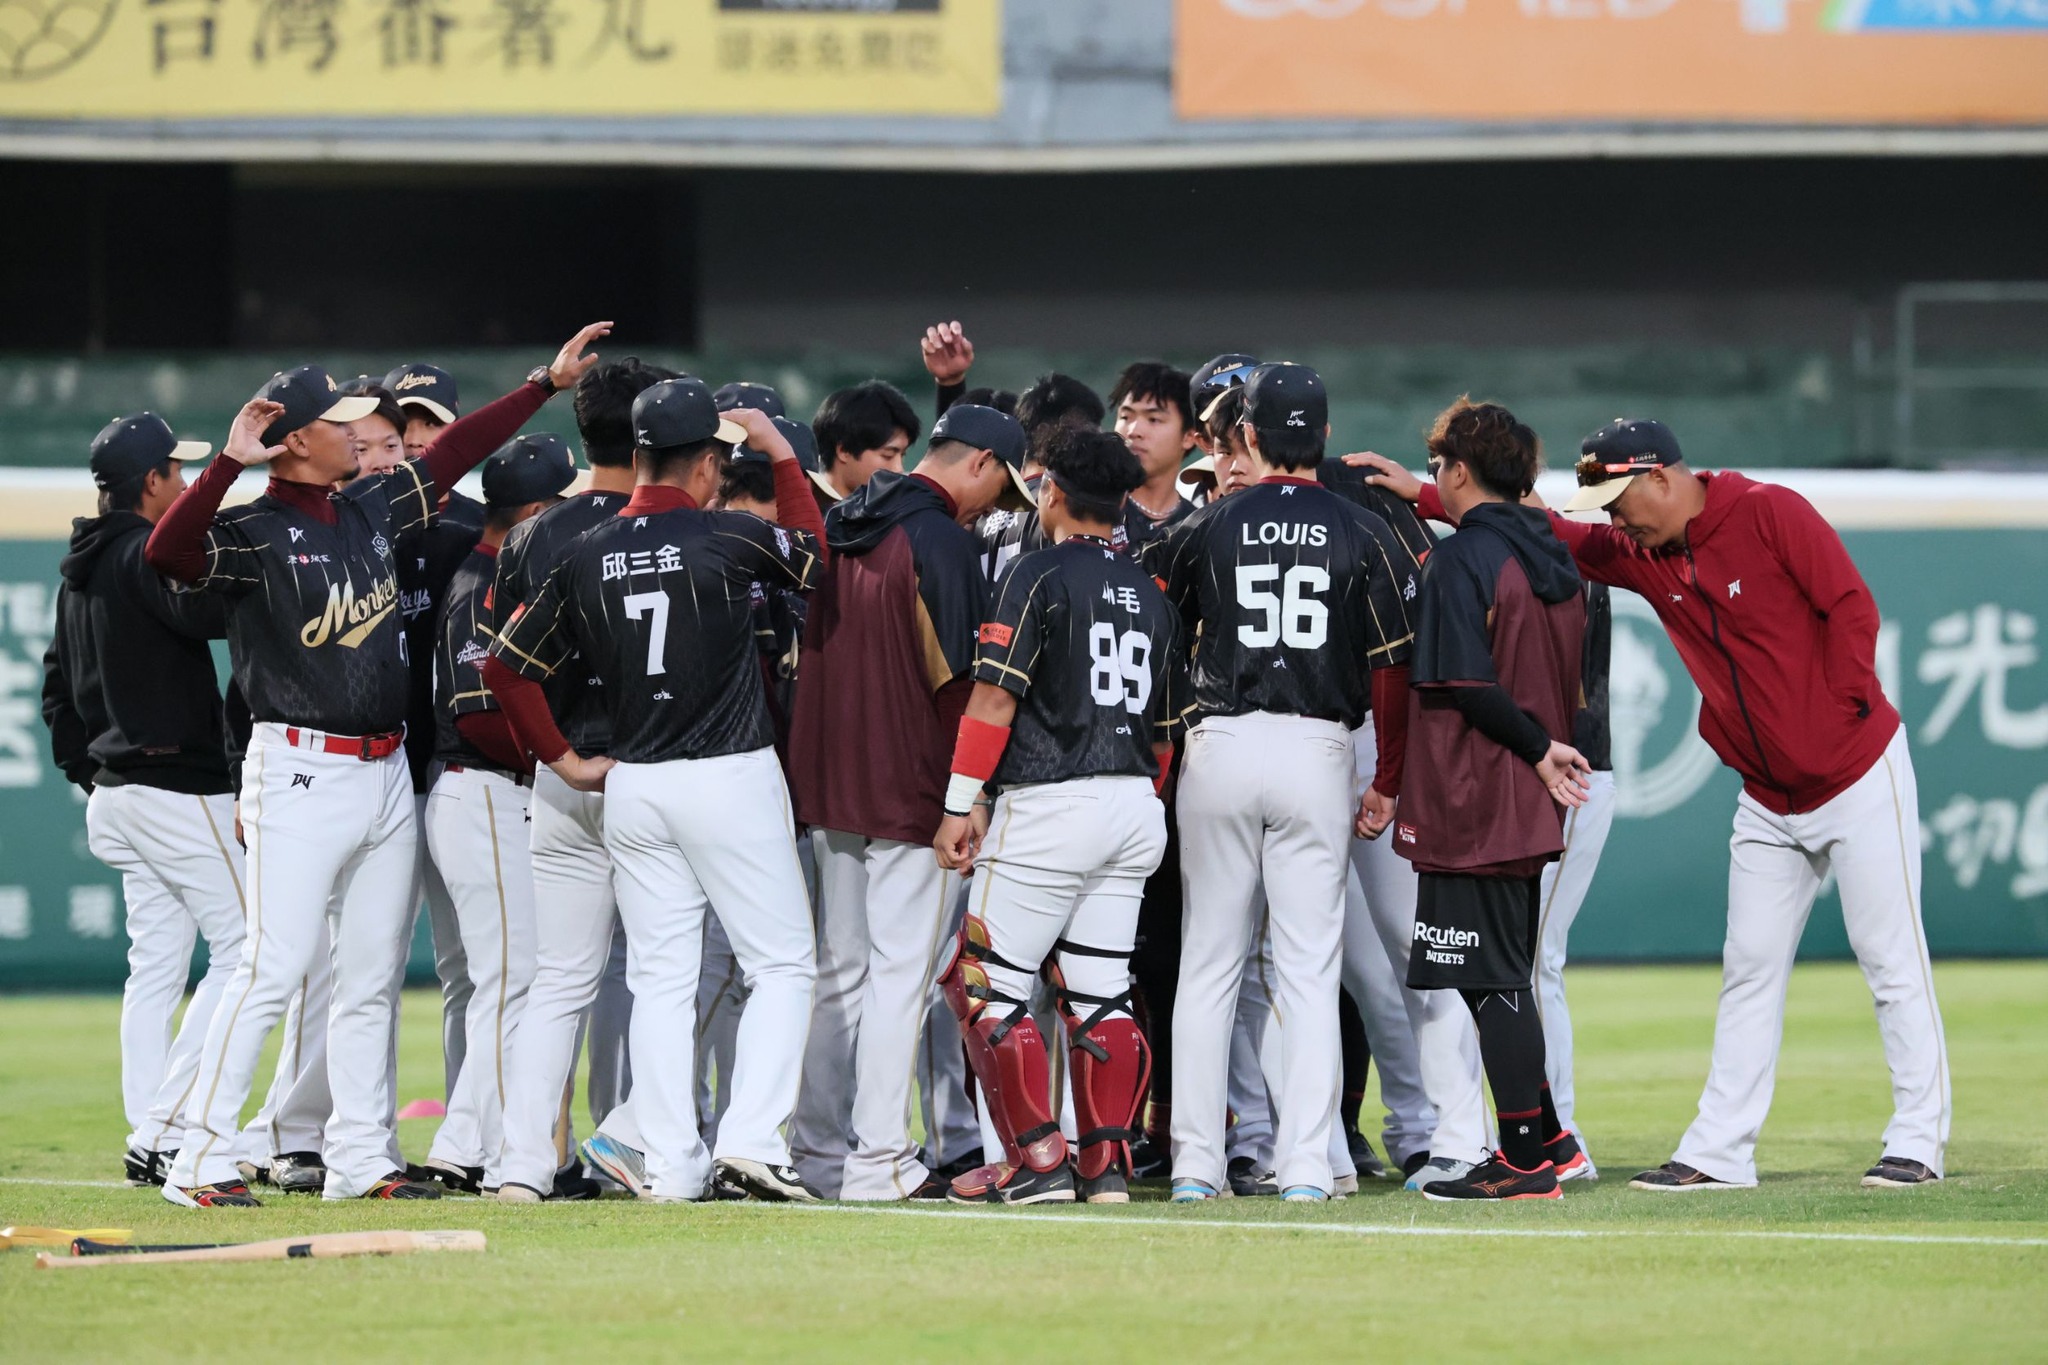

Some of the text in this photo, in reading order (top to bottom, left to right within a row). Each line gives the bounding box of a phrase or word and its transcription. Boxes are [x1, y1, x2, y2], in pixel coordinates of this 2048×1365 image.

[602, 543, 684, 582] 邱三金
[1242, 521, 1328, 547] LOUIS
[623, 590, 670, 676] 7
[1102, 580, 1141, 614] 小毛
[1235, 563, 1331, 650] 56
[1089, 621, 1152, 715] 89
[1874, 603, 2048, 749] 光
